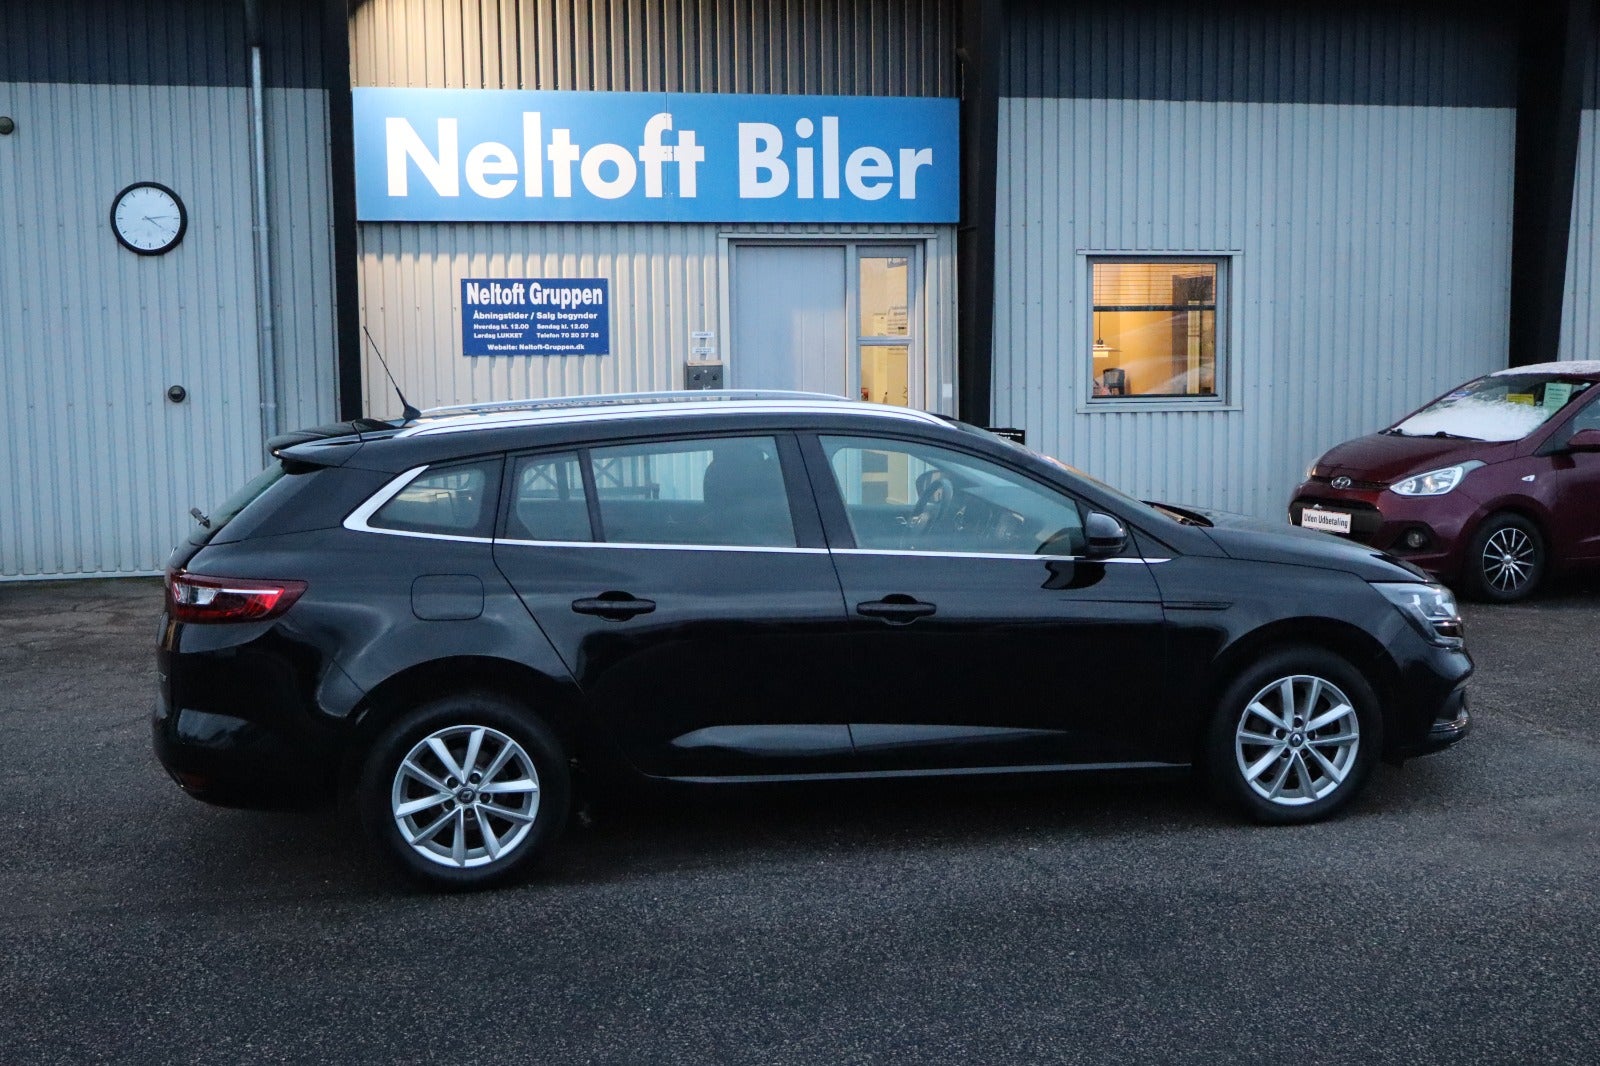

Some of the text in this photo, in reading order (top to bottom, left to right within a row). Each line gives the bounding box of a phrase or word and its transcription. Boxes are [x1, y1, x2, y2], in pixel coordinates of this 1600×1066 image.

[386, 112, 932, 200] Neltoft Biler
[466, 282, 602, 309] Neltoft Gruppen
[473, 310, 528, 320] Åbningstider
[537, 312, 555, 320] Salg
[557, 312, 597, 320] begynder
[474, 323, 500, 331] Hverdag
[537, 323, 560, 331] Søndag
